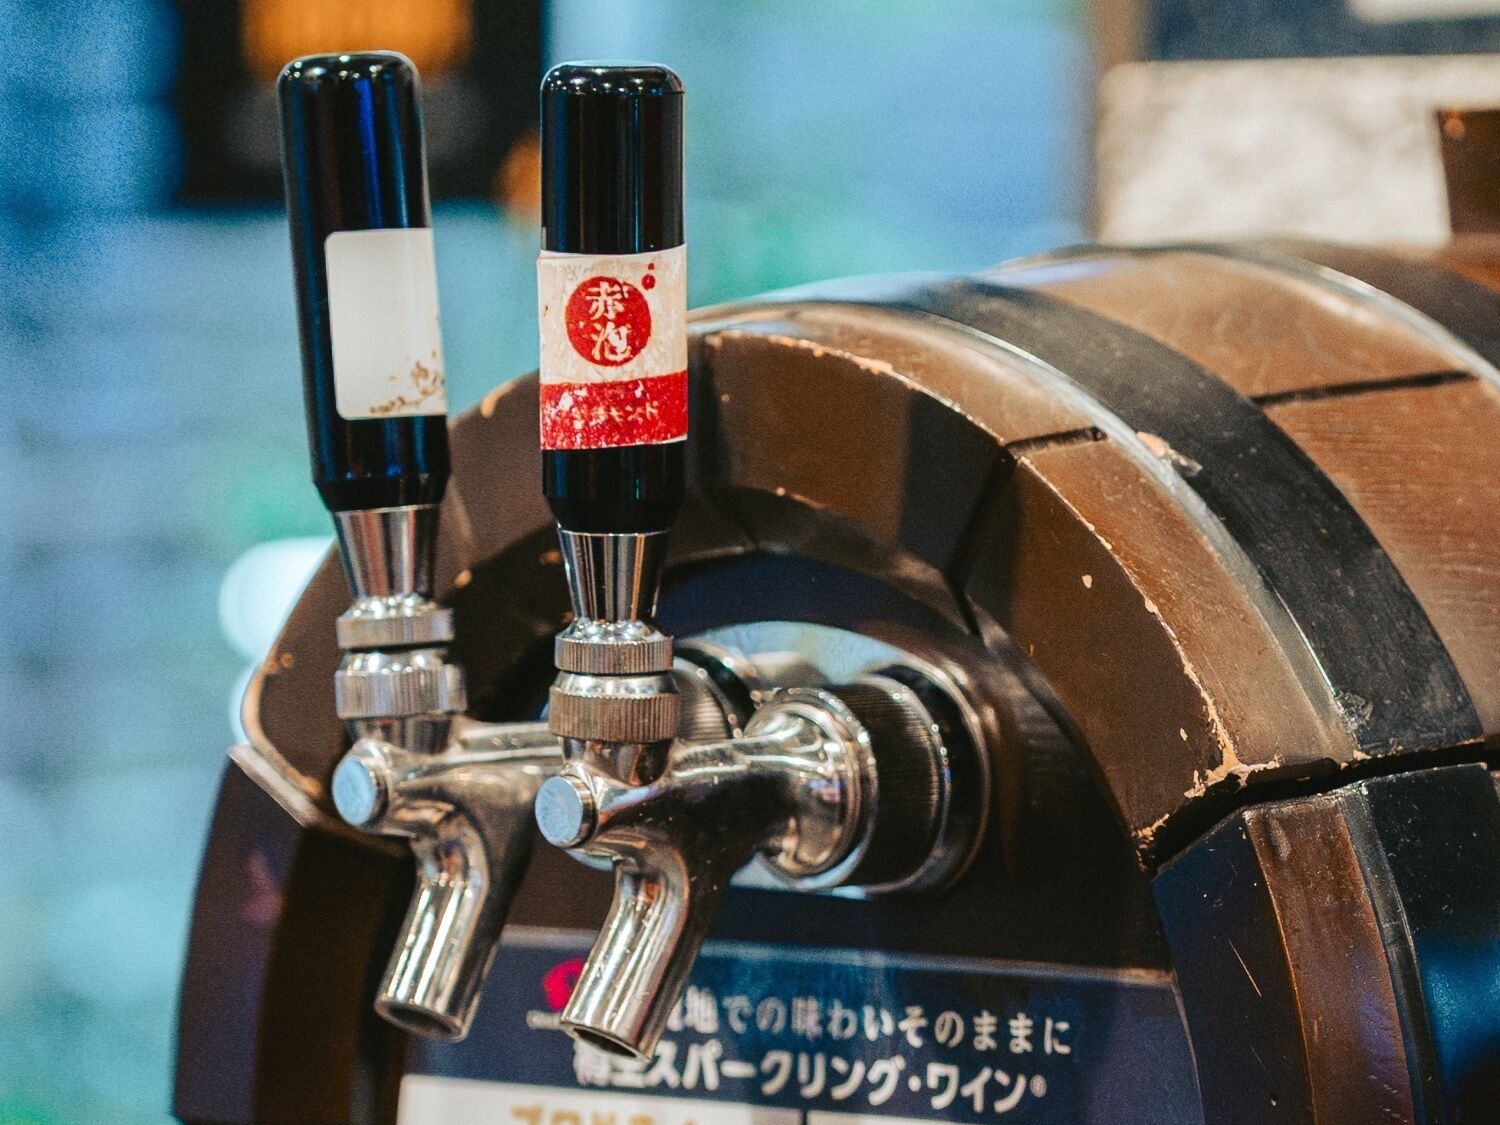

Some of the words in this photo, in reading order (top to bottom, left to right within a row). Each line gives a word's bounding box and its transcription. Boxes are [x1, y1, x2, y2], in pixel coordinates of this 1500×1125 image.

[666, 984, 1072, 1056] 地での味わいそのままに
